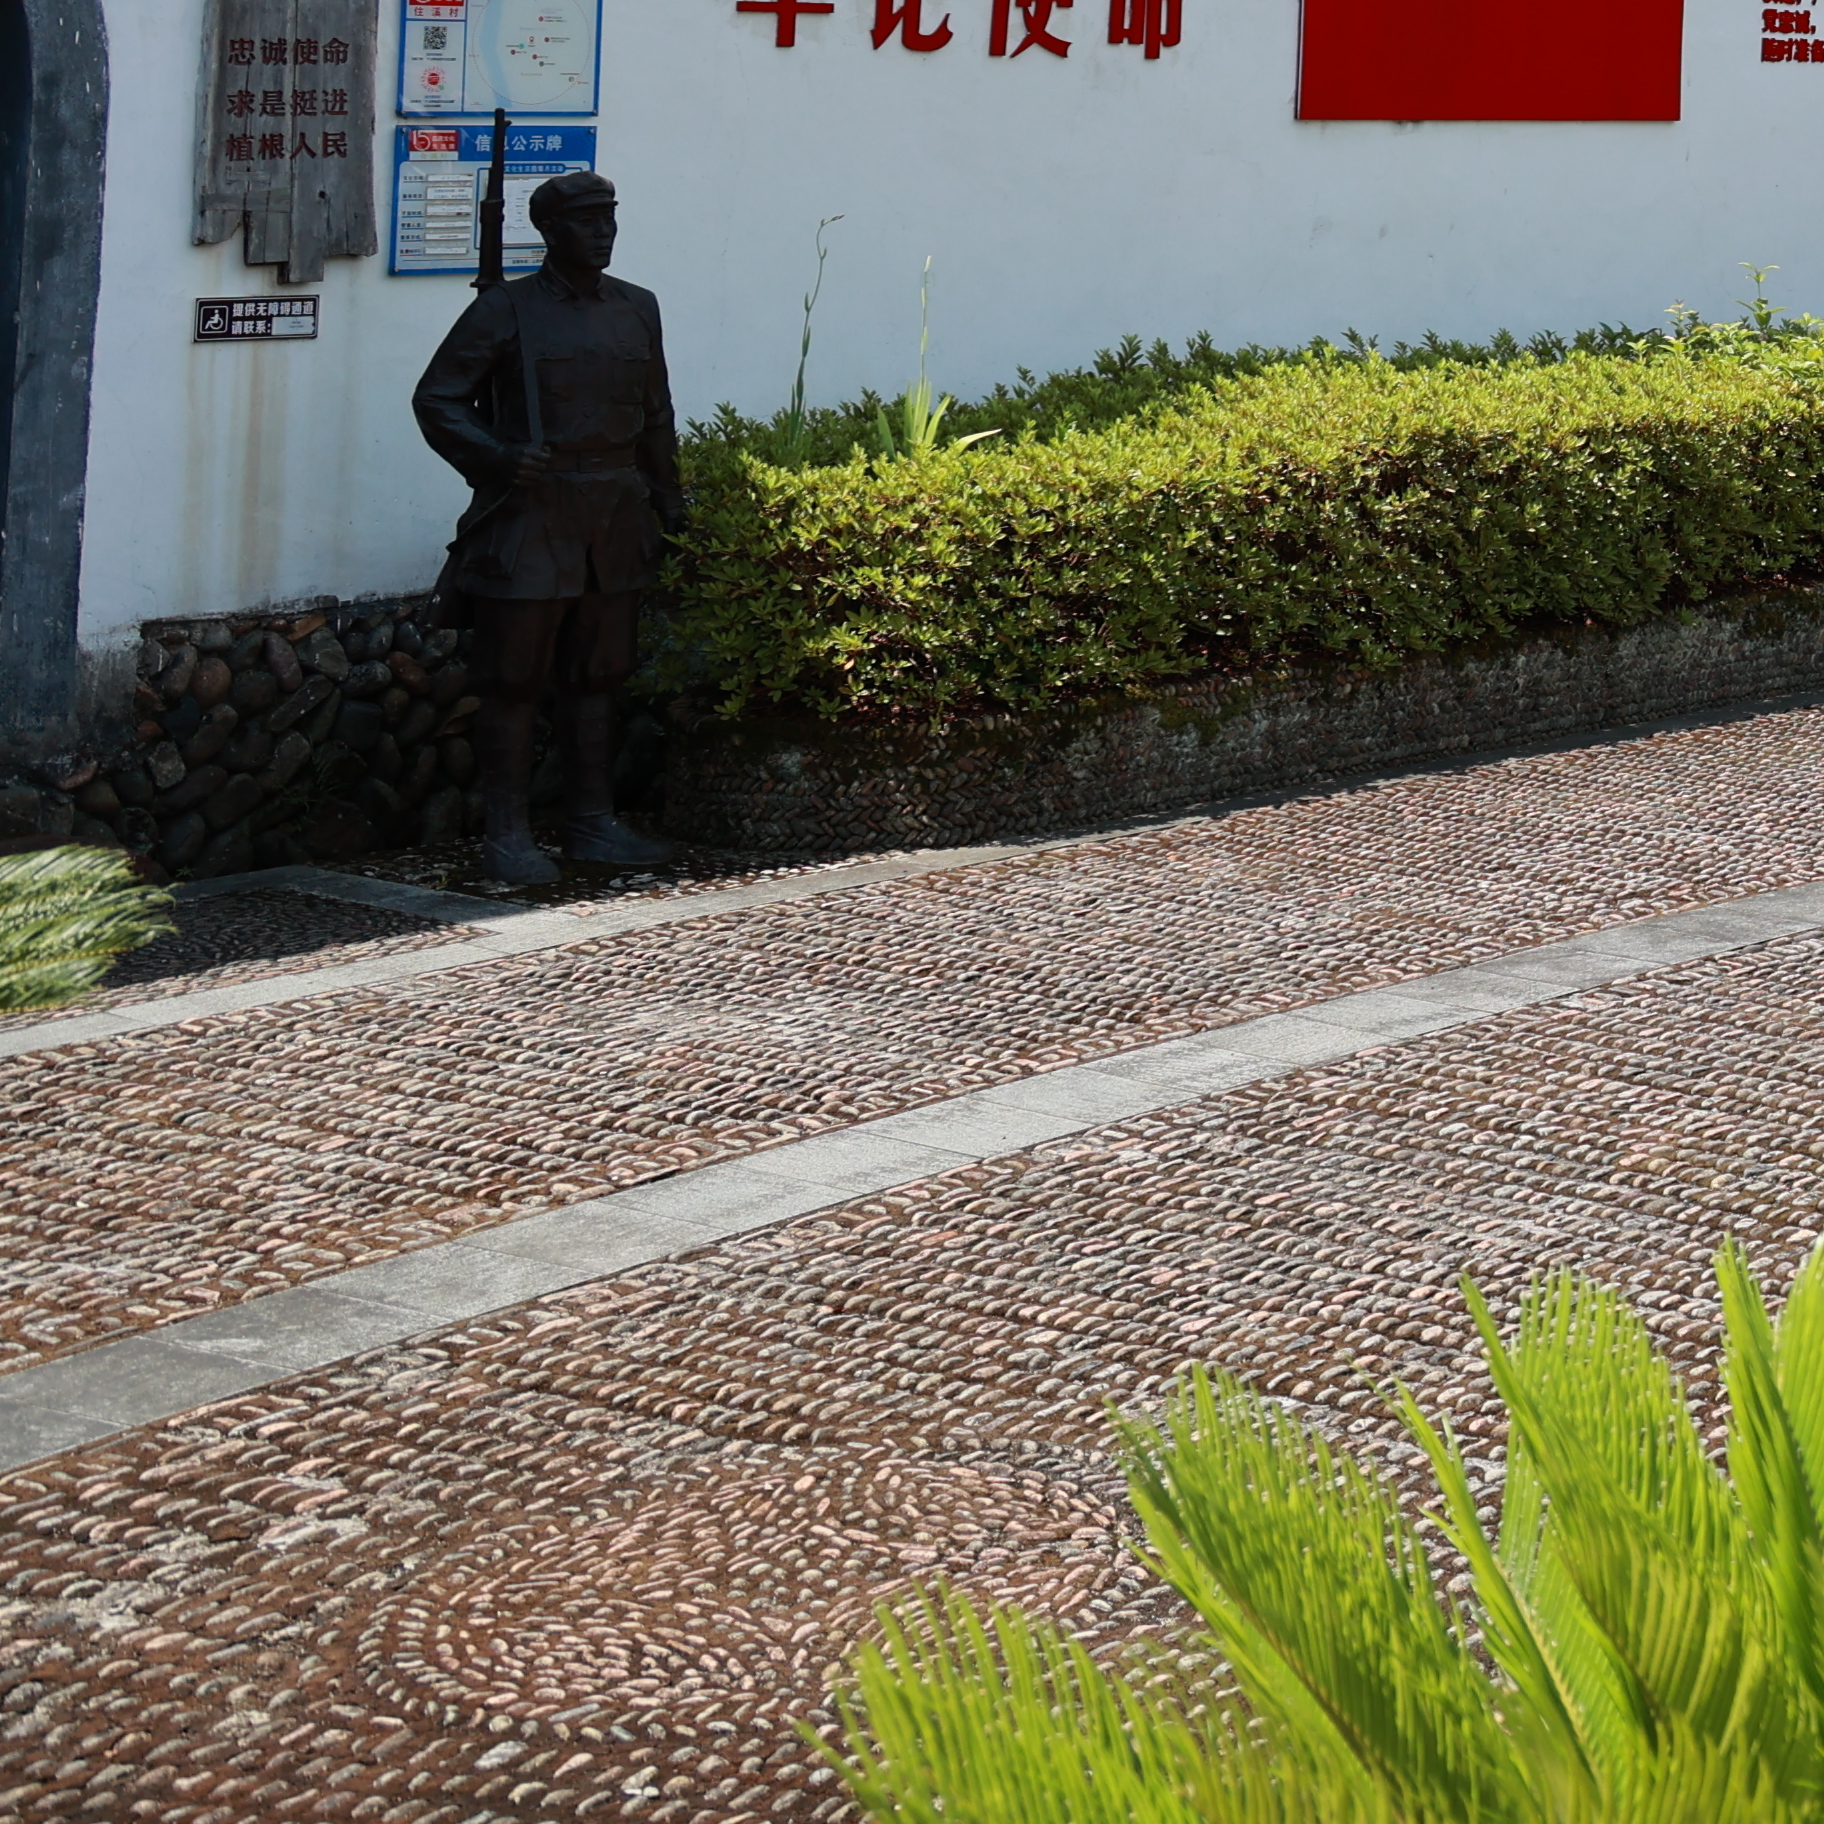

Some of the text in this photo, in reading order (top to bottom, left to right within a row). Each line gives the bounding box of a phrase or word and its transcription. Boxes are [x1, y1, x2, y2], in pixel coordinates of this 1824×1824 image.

[228, 37, 350, 67] 忠诚使命
[226, 88, 349, 119] 求是挺进
[225, 130, 348, 163] 植根人民
[475, 134, 563, 152] 信公示牌
[232, 301, 314, 317] 提供无障碍通道
